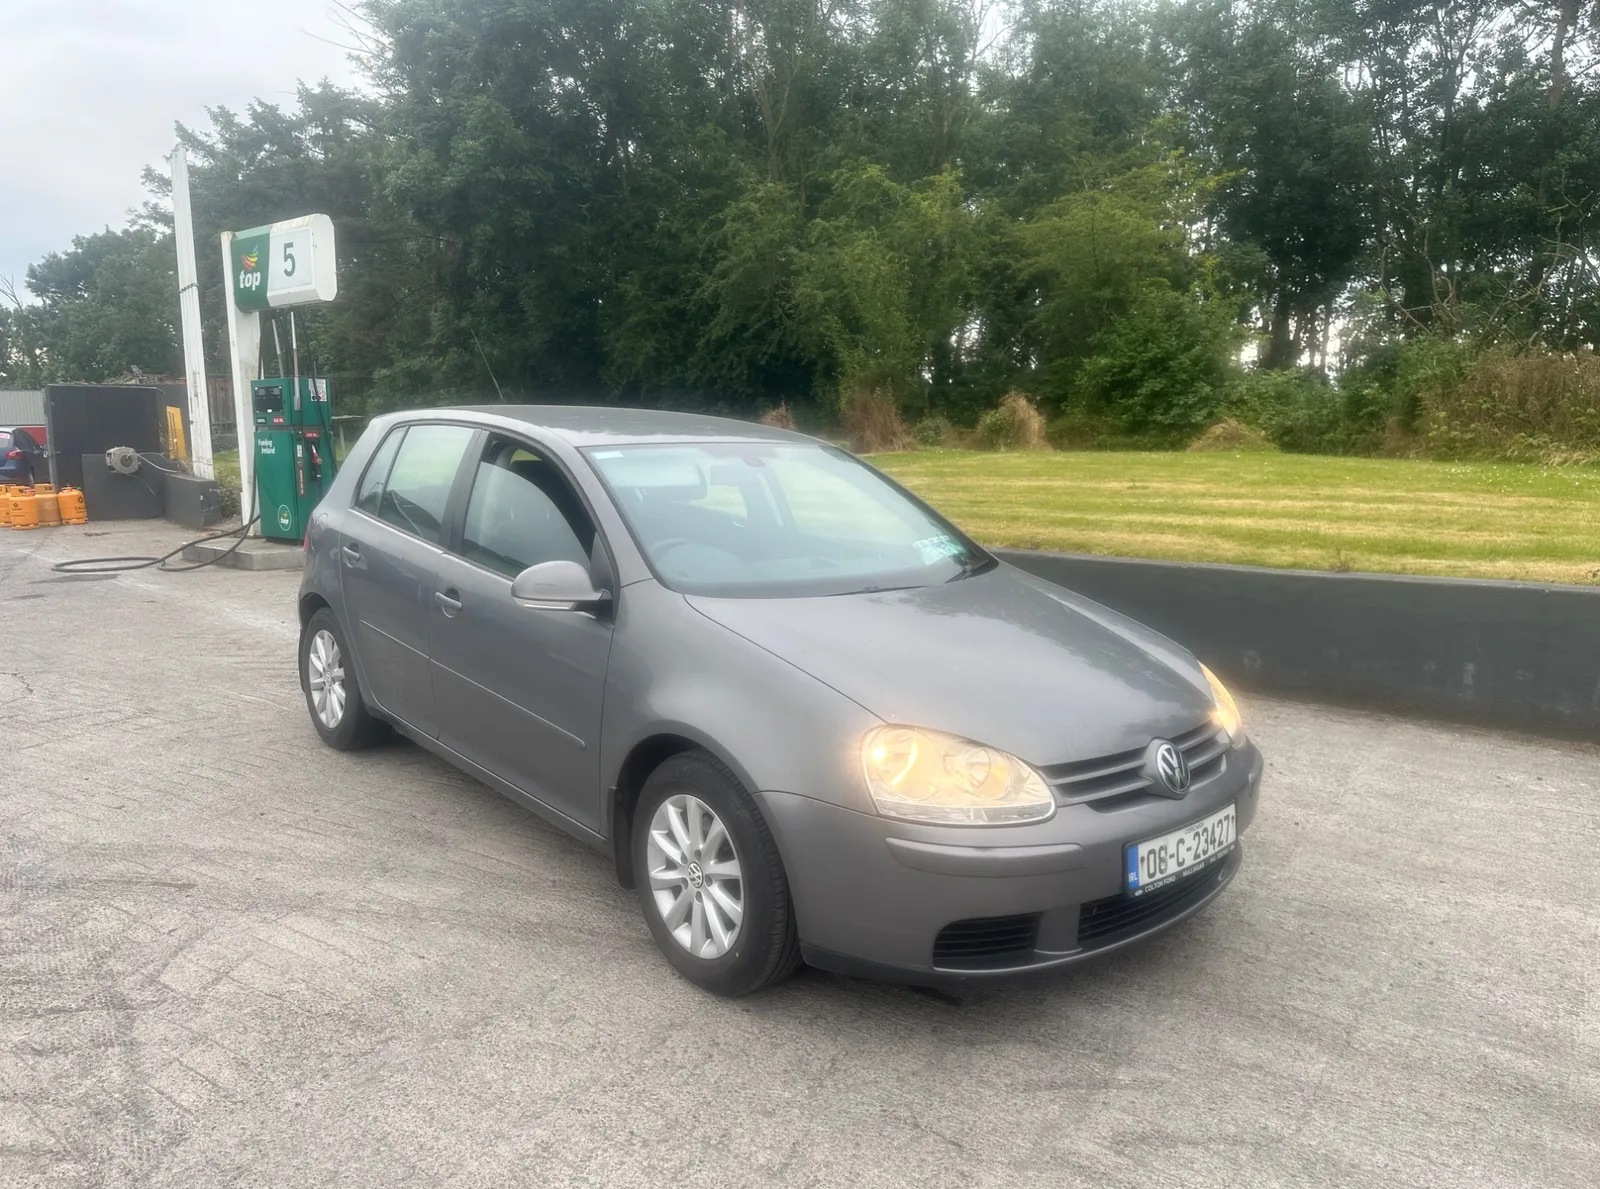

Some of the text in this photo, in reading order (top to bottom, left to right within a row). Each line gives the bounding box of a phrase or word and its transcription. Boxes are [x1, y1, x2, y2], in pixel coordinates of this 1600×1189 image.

[283, 242, 296, 277] 5
[239, 270, 261, 291] top
[280, 517, 289, 526] top
[1146, 813, 1230, 879] 08-C-23427
[1128, 871, 1138, 883] IRL
[1163, 875, 1176, 886] FORD
